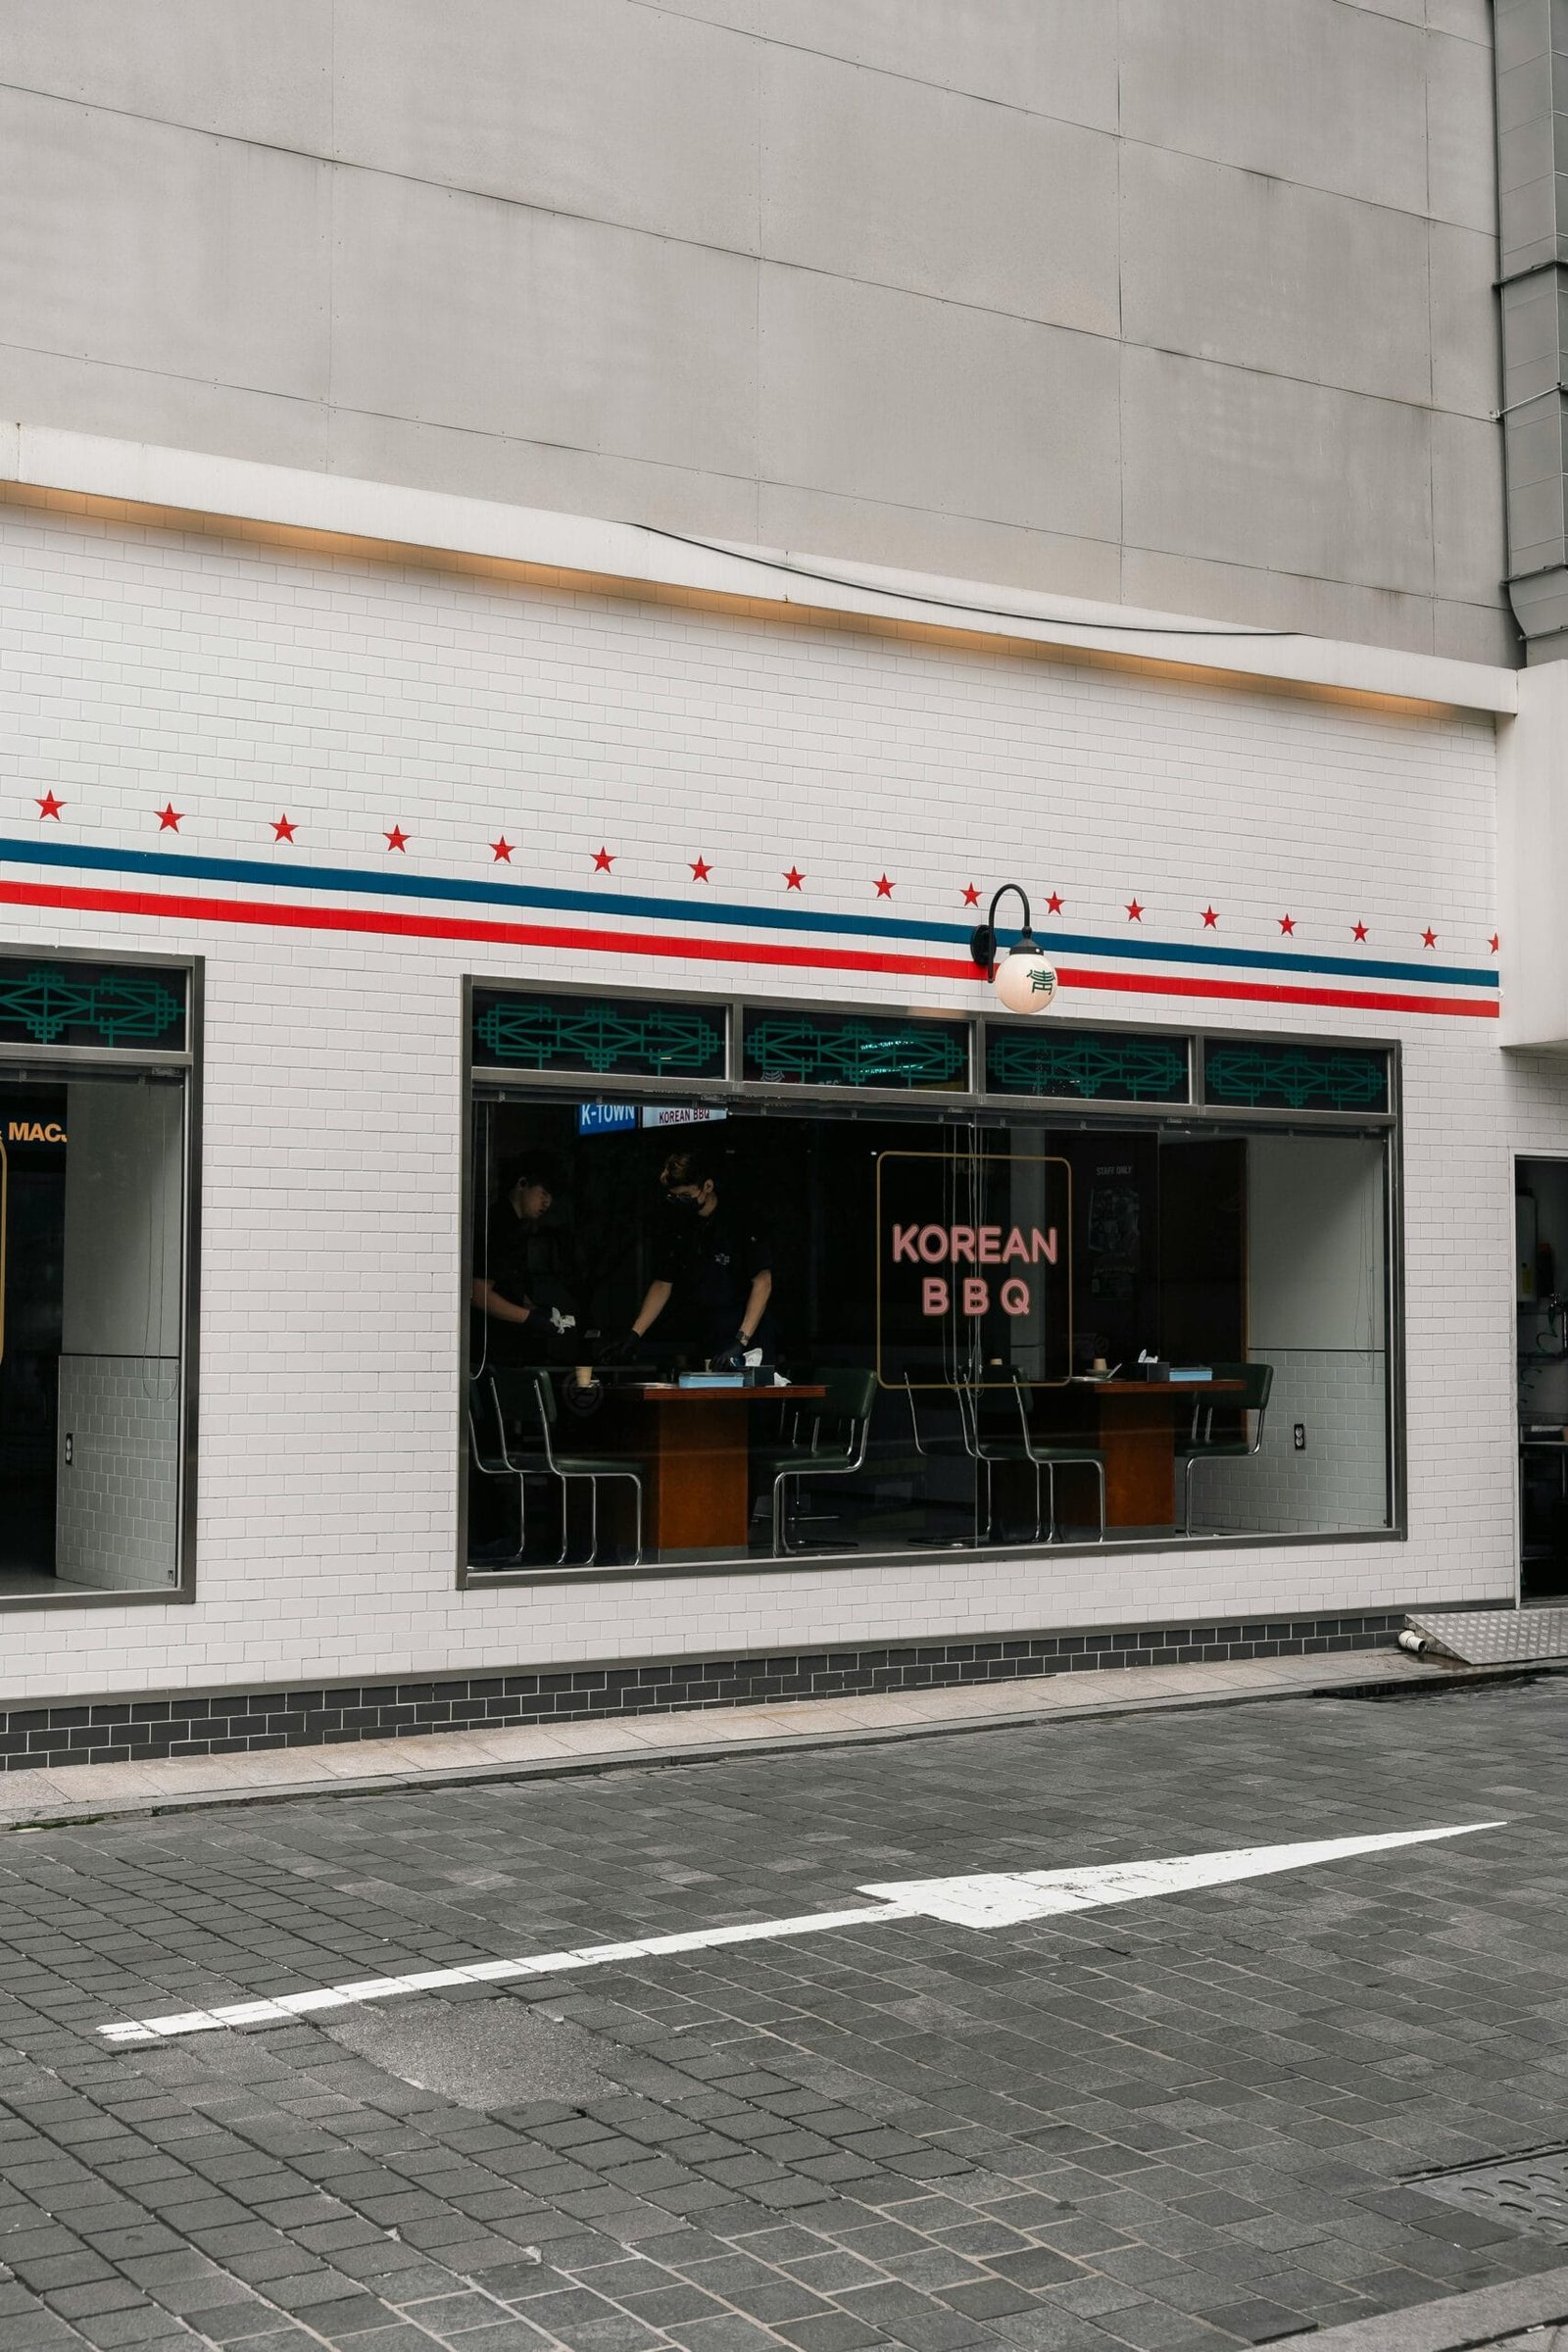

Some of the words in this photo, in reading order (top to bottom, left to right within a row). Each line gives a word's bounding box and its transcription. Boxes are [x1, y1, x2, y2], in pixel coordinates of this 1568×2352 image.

[581, 1104, 635, 1125] K-TOWN
[659, 1109, 691, 1124] KOREAN
[693, 1108, 710, 1120] BBQ
[893, 1223, 1058, 1265] KOREAN
